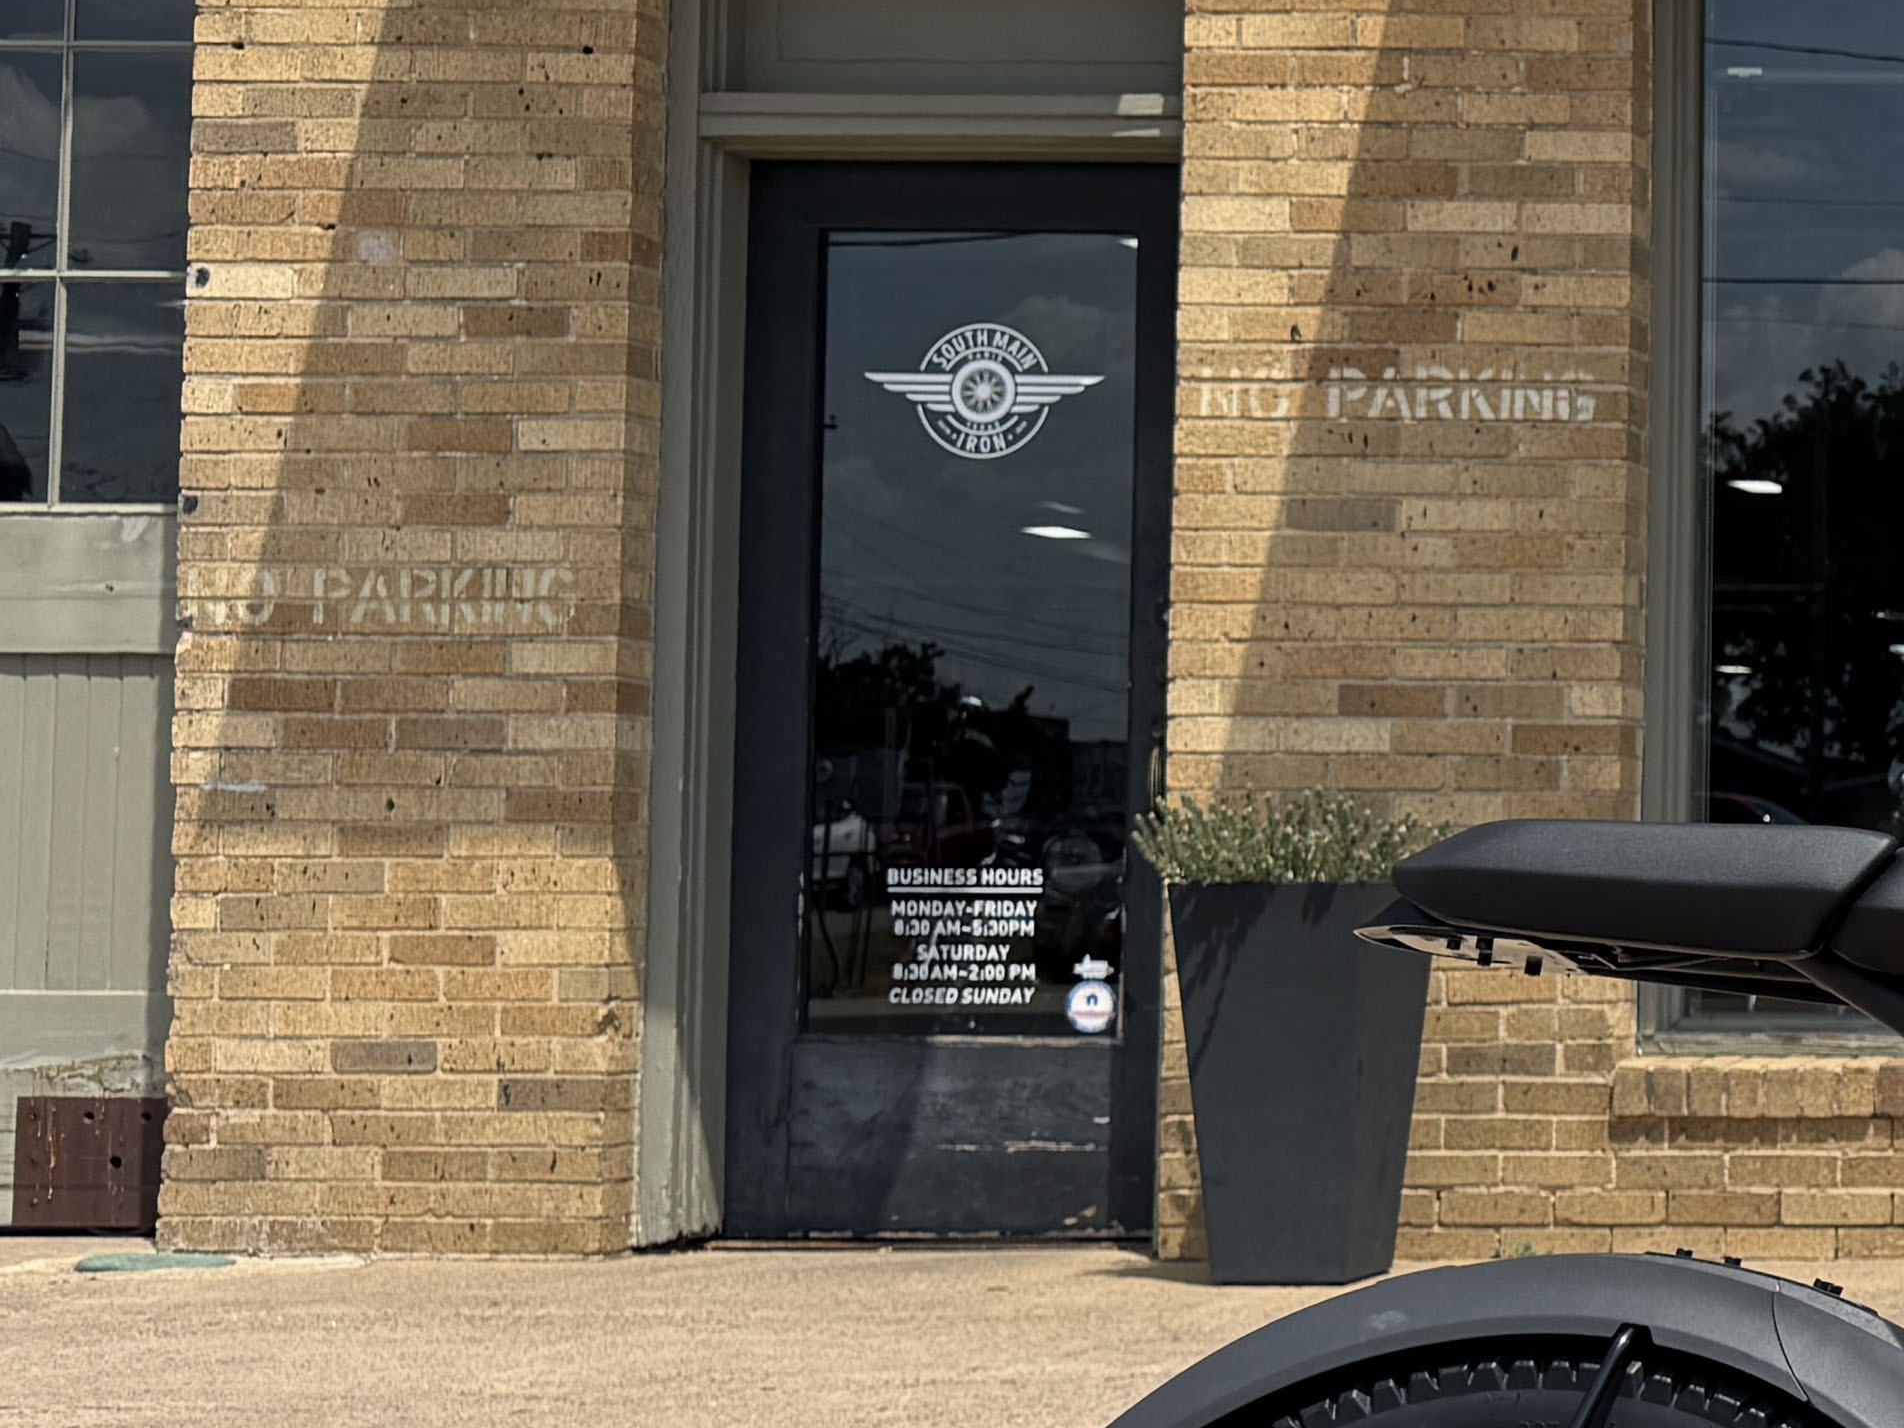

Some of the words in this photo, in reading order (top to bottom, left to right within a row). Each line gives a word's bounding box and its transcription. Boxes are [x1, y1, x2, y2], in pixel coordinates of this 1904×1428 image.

[931, 328, 989, 369] SOUTH
[991, 330, 1039, 370] MAIN
[1199, 365, 1291, 419] NO
[1326, 364, 1598, 421] PARKING
[955, 433, 1007, 453] IRON
[186, 566, 277, 628] NO
[888, 869, 976, 885] BUSINESS
[981, 869, 1043, 885] HOURS
[918, 944, 1010, 960] SATURDAY
[889, 988, 958, 1004] CLOSED
[961, 988, 1035, 1004] SUNDAY
